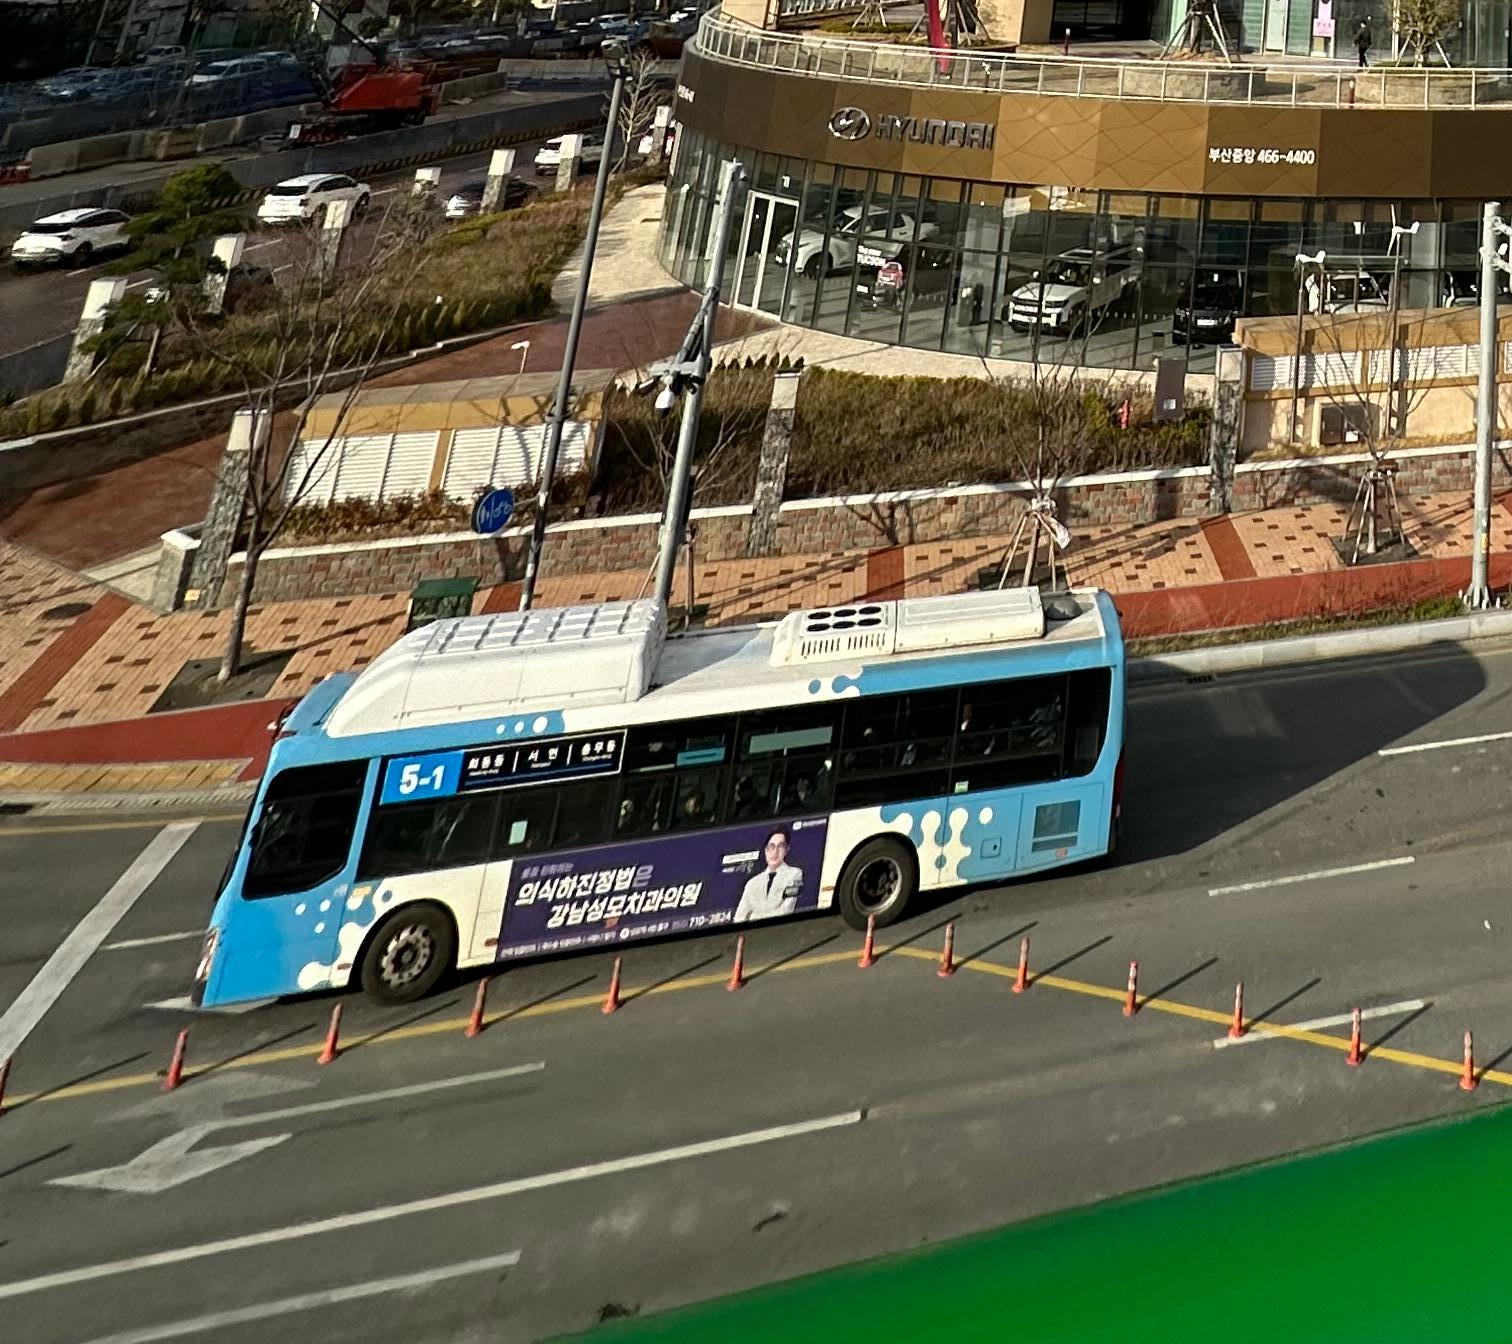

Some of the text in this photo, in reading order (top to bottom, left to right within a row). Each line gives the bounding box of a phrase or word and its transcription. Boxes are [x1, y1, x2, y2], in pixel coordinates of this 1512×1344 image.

[875, 113, 996, 151] HYUNDAI
[1208, 147, 1256, 165] 부산중앙
[399, 763, 447, 795] 5-1
[546, 881, 703, 929] 강남성모치과의원
